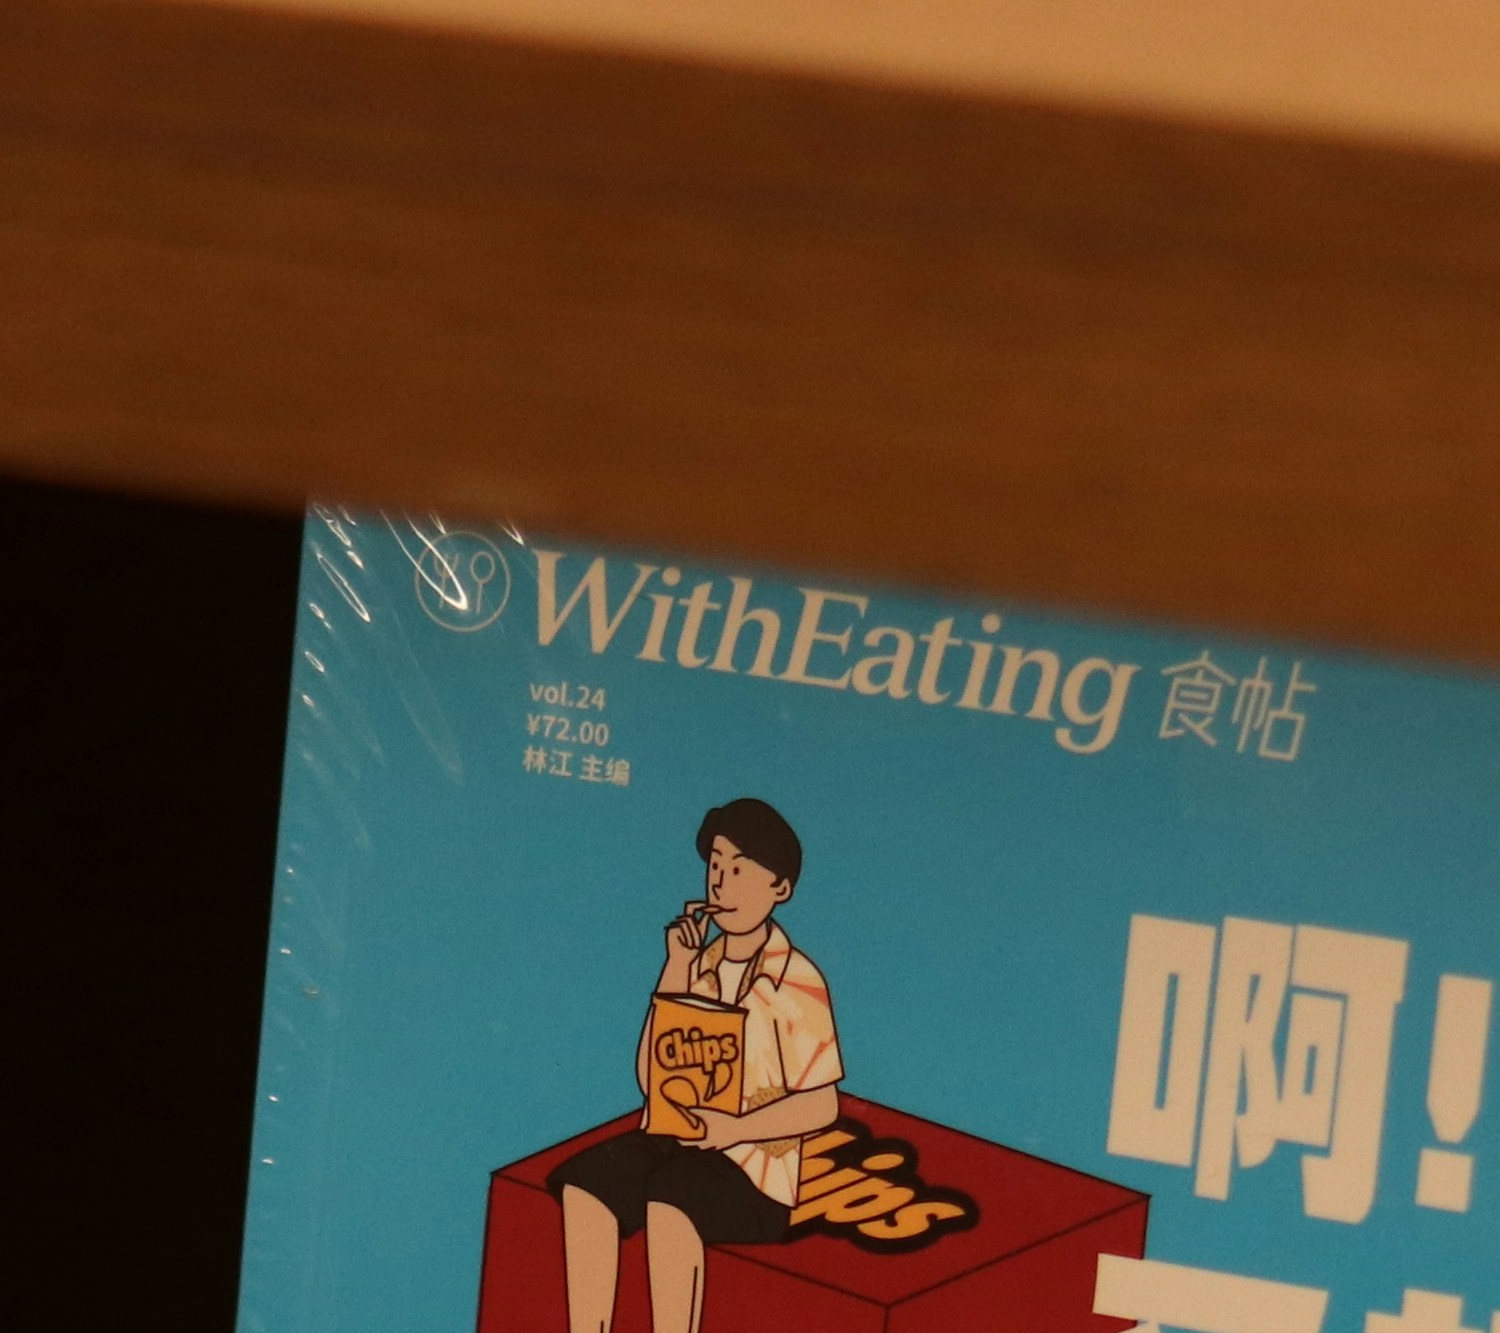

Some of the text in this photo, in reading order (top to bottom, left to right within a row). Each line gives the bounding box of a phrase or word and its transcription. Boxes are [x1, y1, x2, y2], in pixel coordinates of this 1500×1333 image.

[530, 547, 1316, 762] WithEating 食帖
[528, 679, 607, 712] vol.24
[525, 714, 609, 746] ¥72.00
[521, 746, 632, 788] 林江 主编
[654, 1026, 740, 1072] Chips
[1106, 913, 1494, 1225] 啊！
